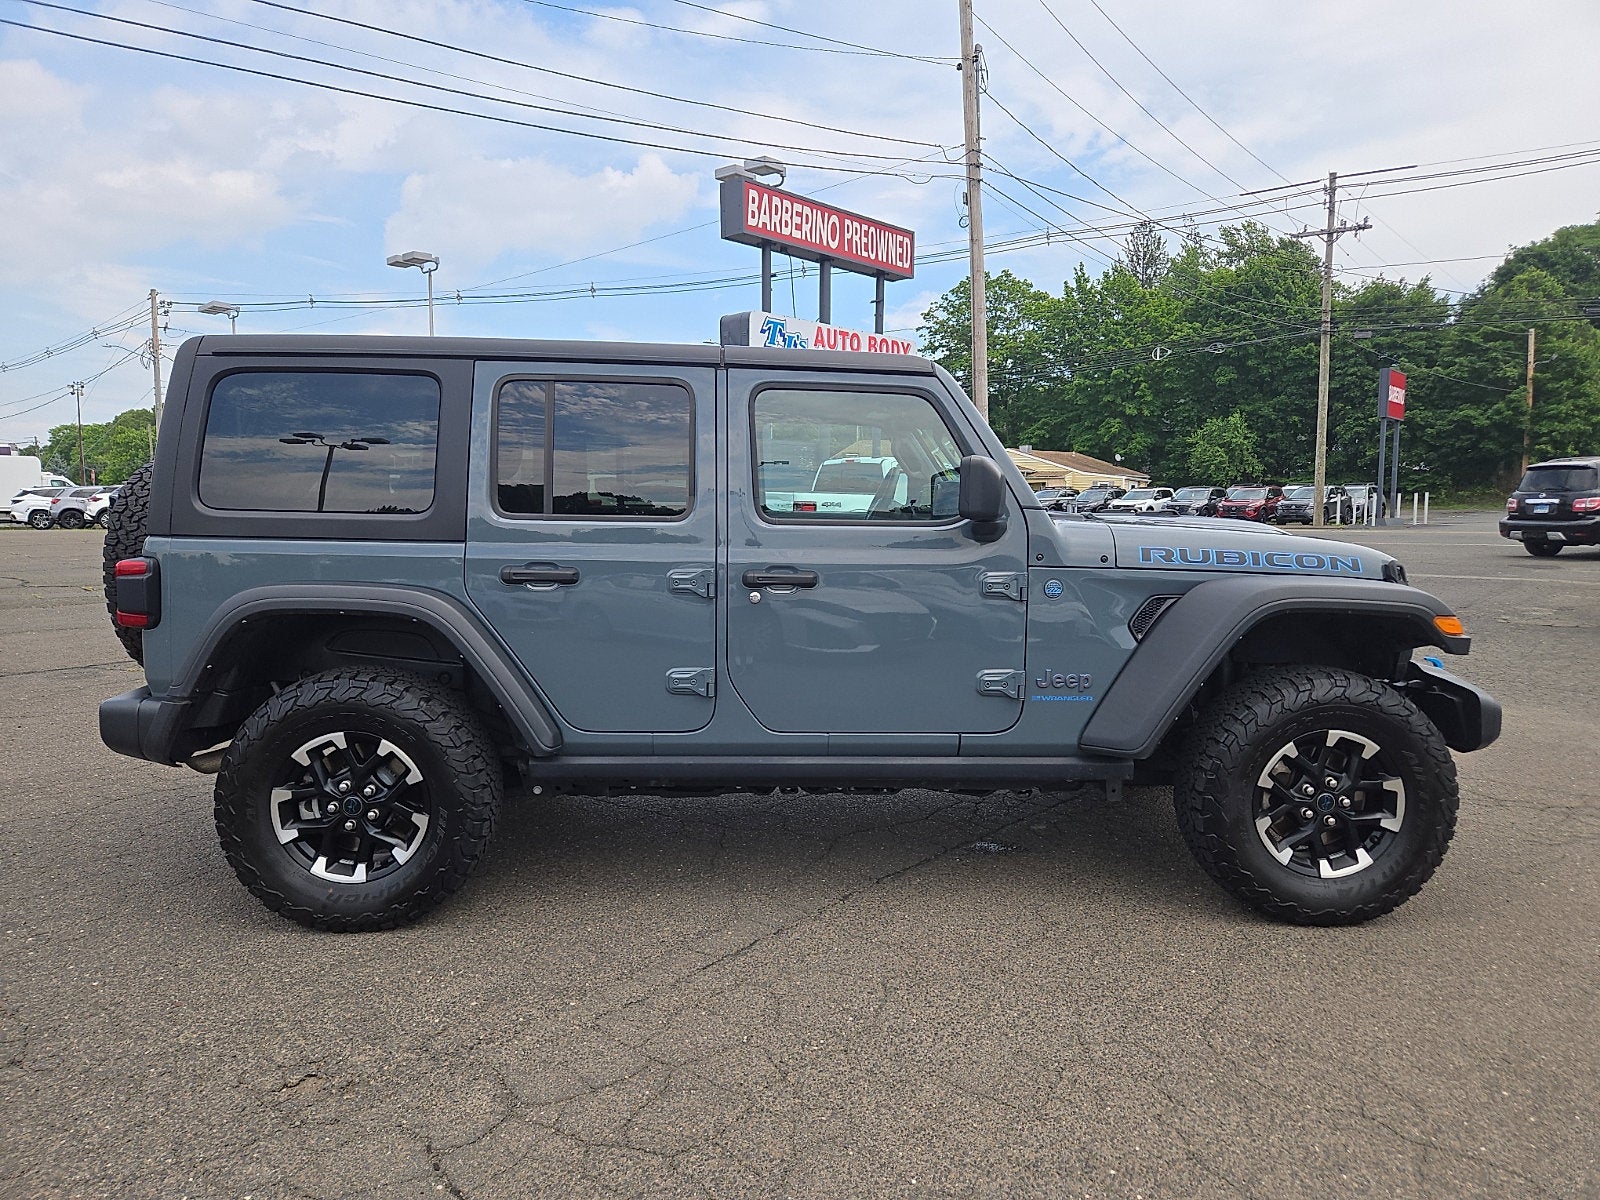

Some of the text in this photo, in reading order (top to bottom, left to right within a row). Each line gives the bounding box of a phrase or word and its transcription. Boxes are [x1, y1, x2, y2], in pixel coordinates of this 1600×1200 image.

[747, 188, 911, 269] BARBERINO PREOWNED
[813, 326, 863, 352] AUTO
[868, 335, 912, 355] BODY
[1139, 546, 1363, 573] RUBICON
[1035, 668, 1094, 692] Jeep
